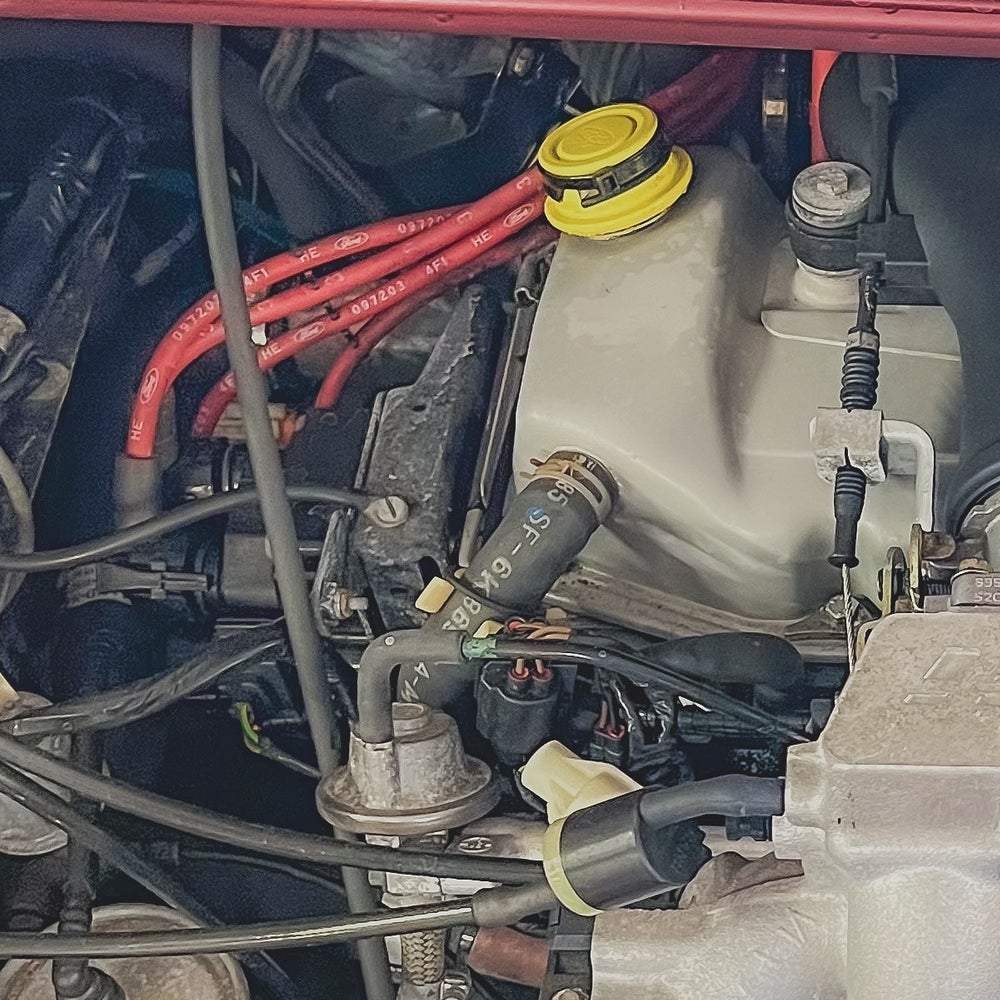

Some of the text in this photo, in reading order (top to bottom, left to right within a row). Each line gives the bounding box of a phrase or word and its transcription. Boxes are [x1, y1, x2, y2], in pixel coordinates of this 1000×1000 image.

[260, 343, 282, 360] HE
[351, 281, 406, 315] 097203
[425, 256, 449, 275] 4F1
[471, 229, 493, 247] HE
[131, 420, 143, 441] HE
